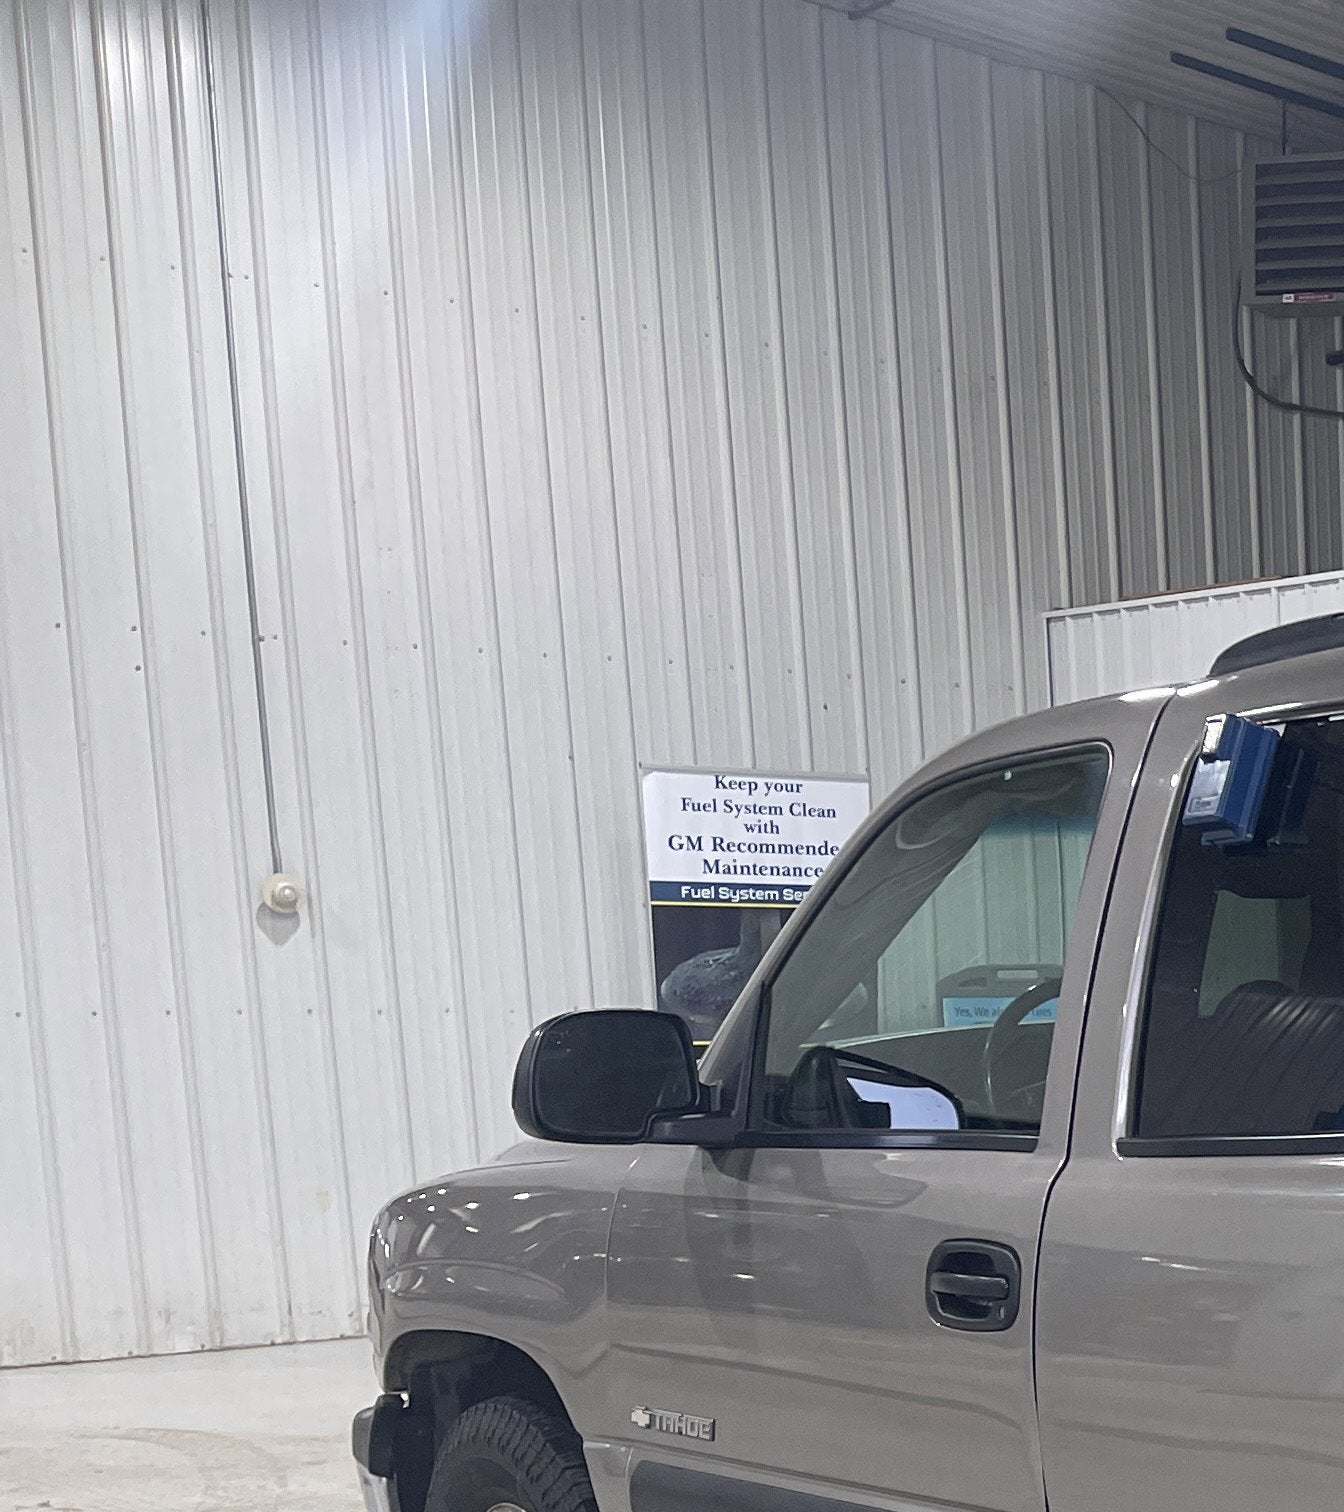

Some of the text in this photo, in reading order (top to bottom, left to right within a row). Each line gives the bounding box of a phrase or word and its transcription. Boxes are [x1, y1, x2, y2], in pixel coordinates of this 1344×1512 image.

[713, 774, 803, 797] Keep your
[680, 797, 837, 819] Fuel System Clean
[743, 819, 780, 835] with
[667, 835, 840, 856] GM Recommende
[702, 859, 824, 878] Maintenance
[681, 885, 808, 903] Fuel System Ser
[974, 1006, 989, 1017] We
[653, 1410, 714, 1441] TAHOE
